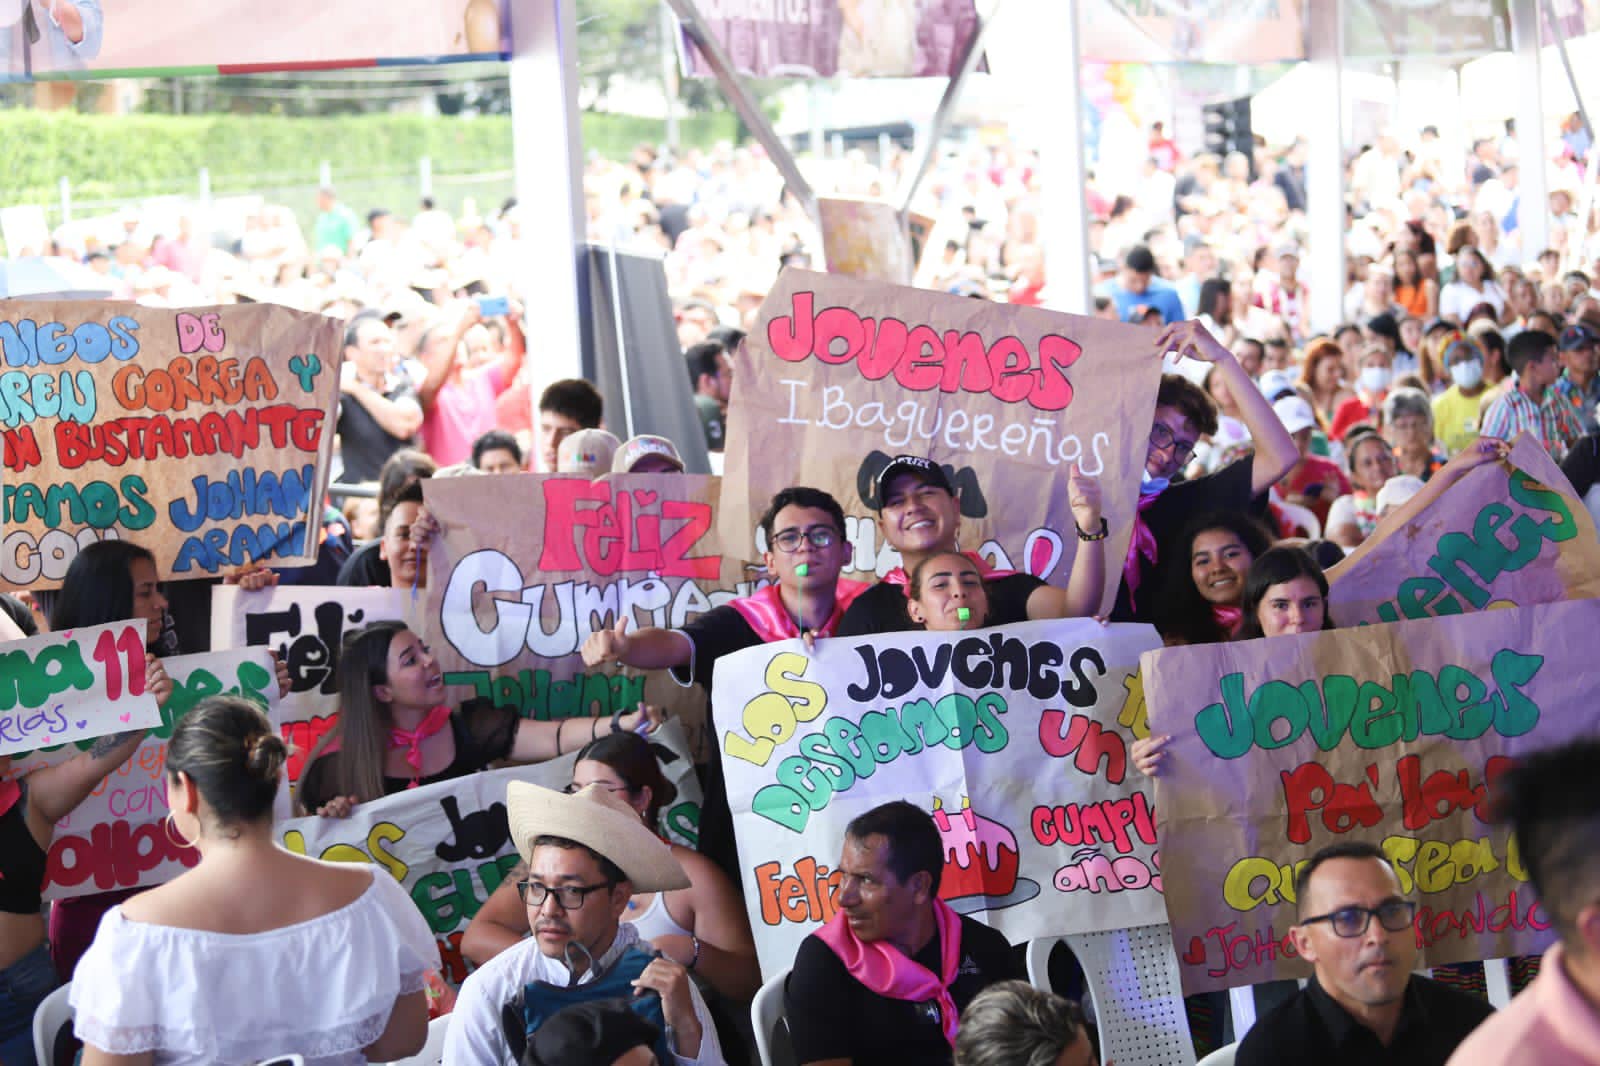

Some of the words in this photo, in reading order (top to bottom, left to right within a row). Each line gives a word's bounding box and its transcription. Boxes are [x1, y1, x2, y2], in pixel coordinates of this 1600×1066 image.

[176, 312, 227, 354] DE
[768, 291, 1082, 411] Jovenes
[111, 355, 279, 412] CORREA
[288, 353, 322, 392] Y
[54, 404, 325, 469] BUSTAMANTE
[1195, 648, 1545, 760] Jovenes
